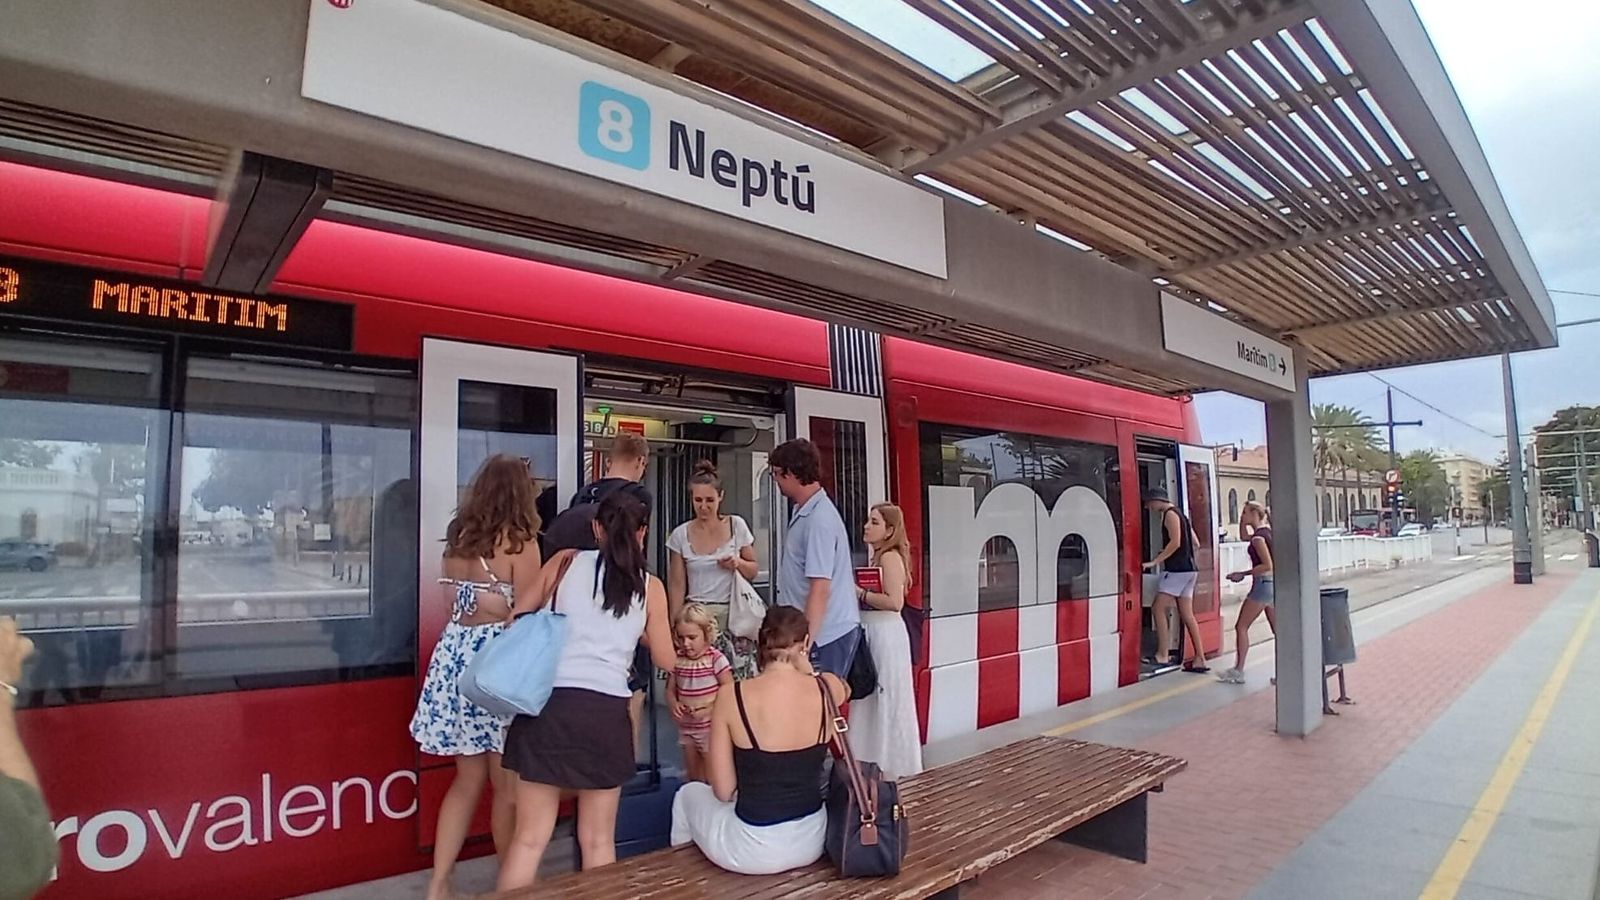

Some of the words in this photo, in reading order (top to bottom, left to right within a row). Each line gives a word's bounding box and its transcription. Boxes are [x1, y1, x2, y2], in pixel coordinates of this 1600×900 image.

[597, 99, 634, 154] 8
[668, 119, 816, 215] Neptú
[92, 279, 288, 332] MARITIM
